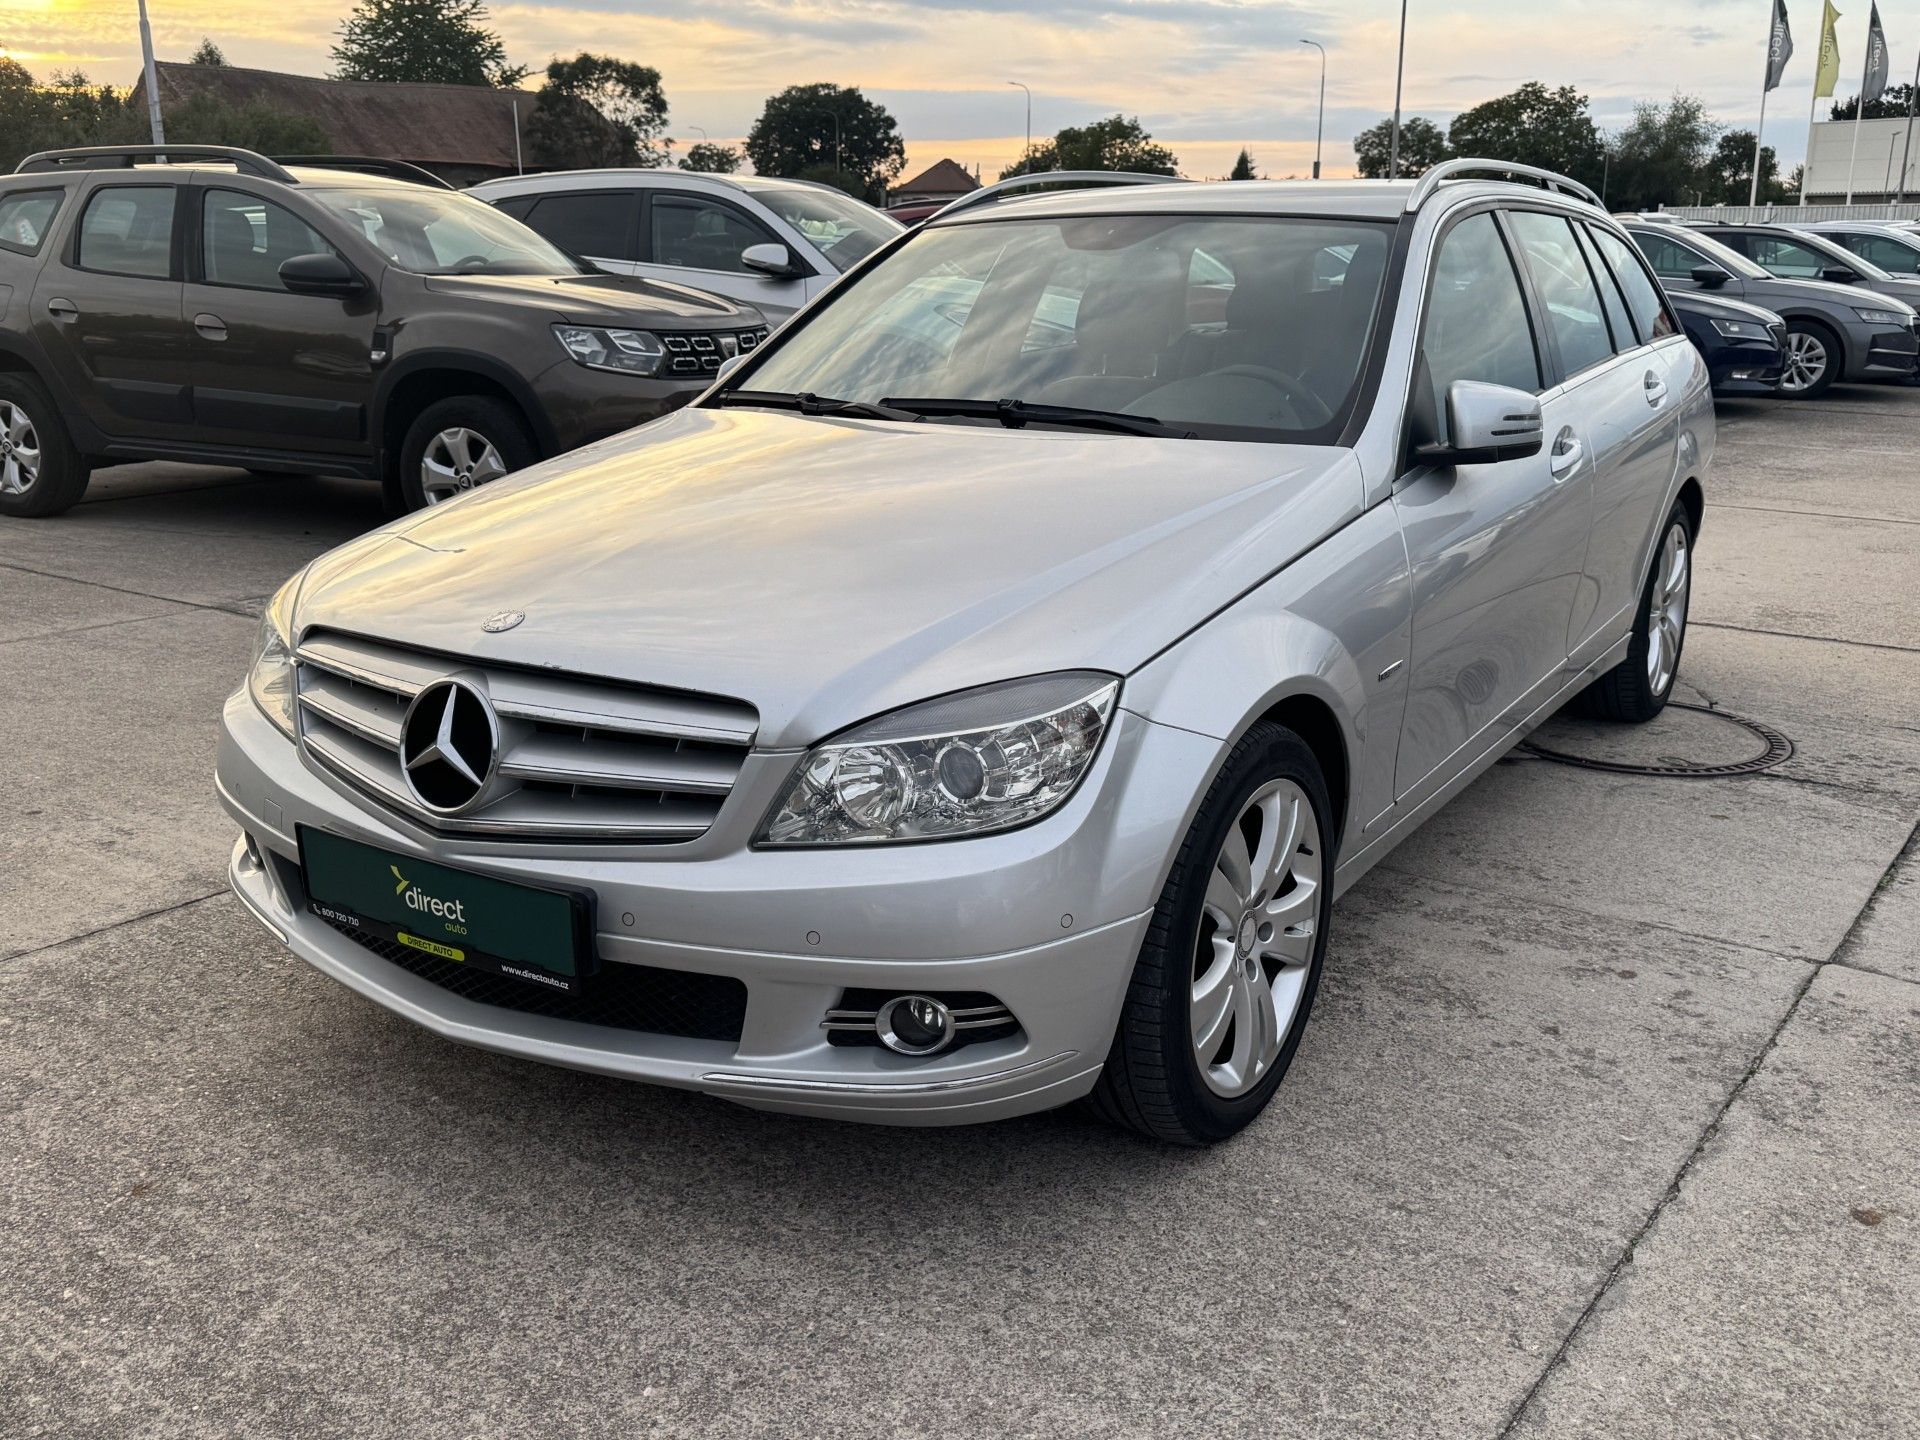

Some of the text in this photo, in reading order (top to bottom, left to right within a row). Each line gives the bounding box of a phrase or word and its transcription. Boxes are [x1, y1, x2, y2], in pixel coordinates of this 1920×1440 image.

[321, 907, 335, 918] 800
[335, 911, 347, 922] 720
[405, 886, 466, 923] direct
[445, 922, 468, 935] auto
[407, 936, 453, 957] DIRECT AUTO
[501, 964, 569, 990] www.directauto.cz
